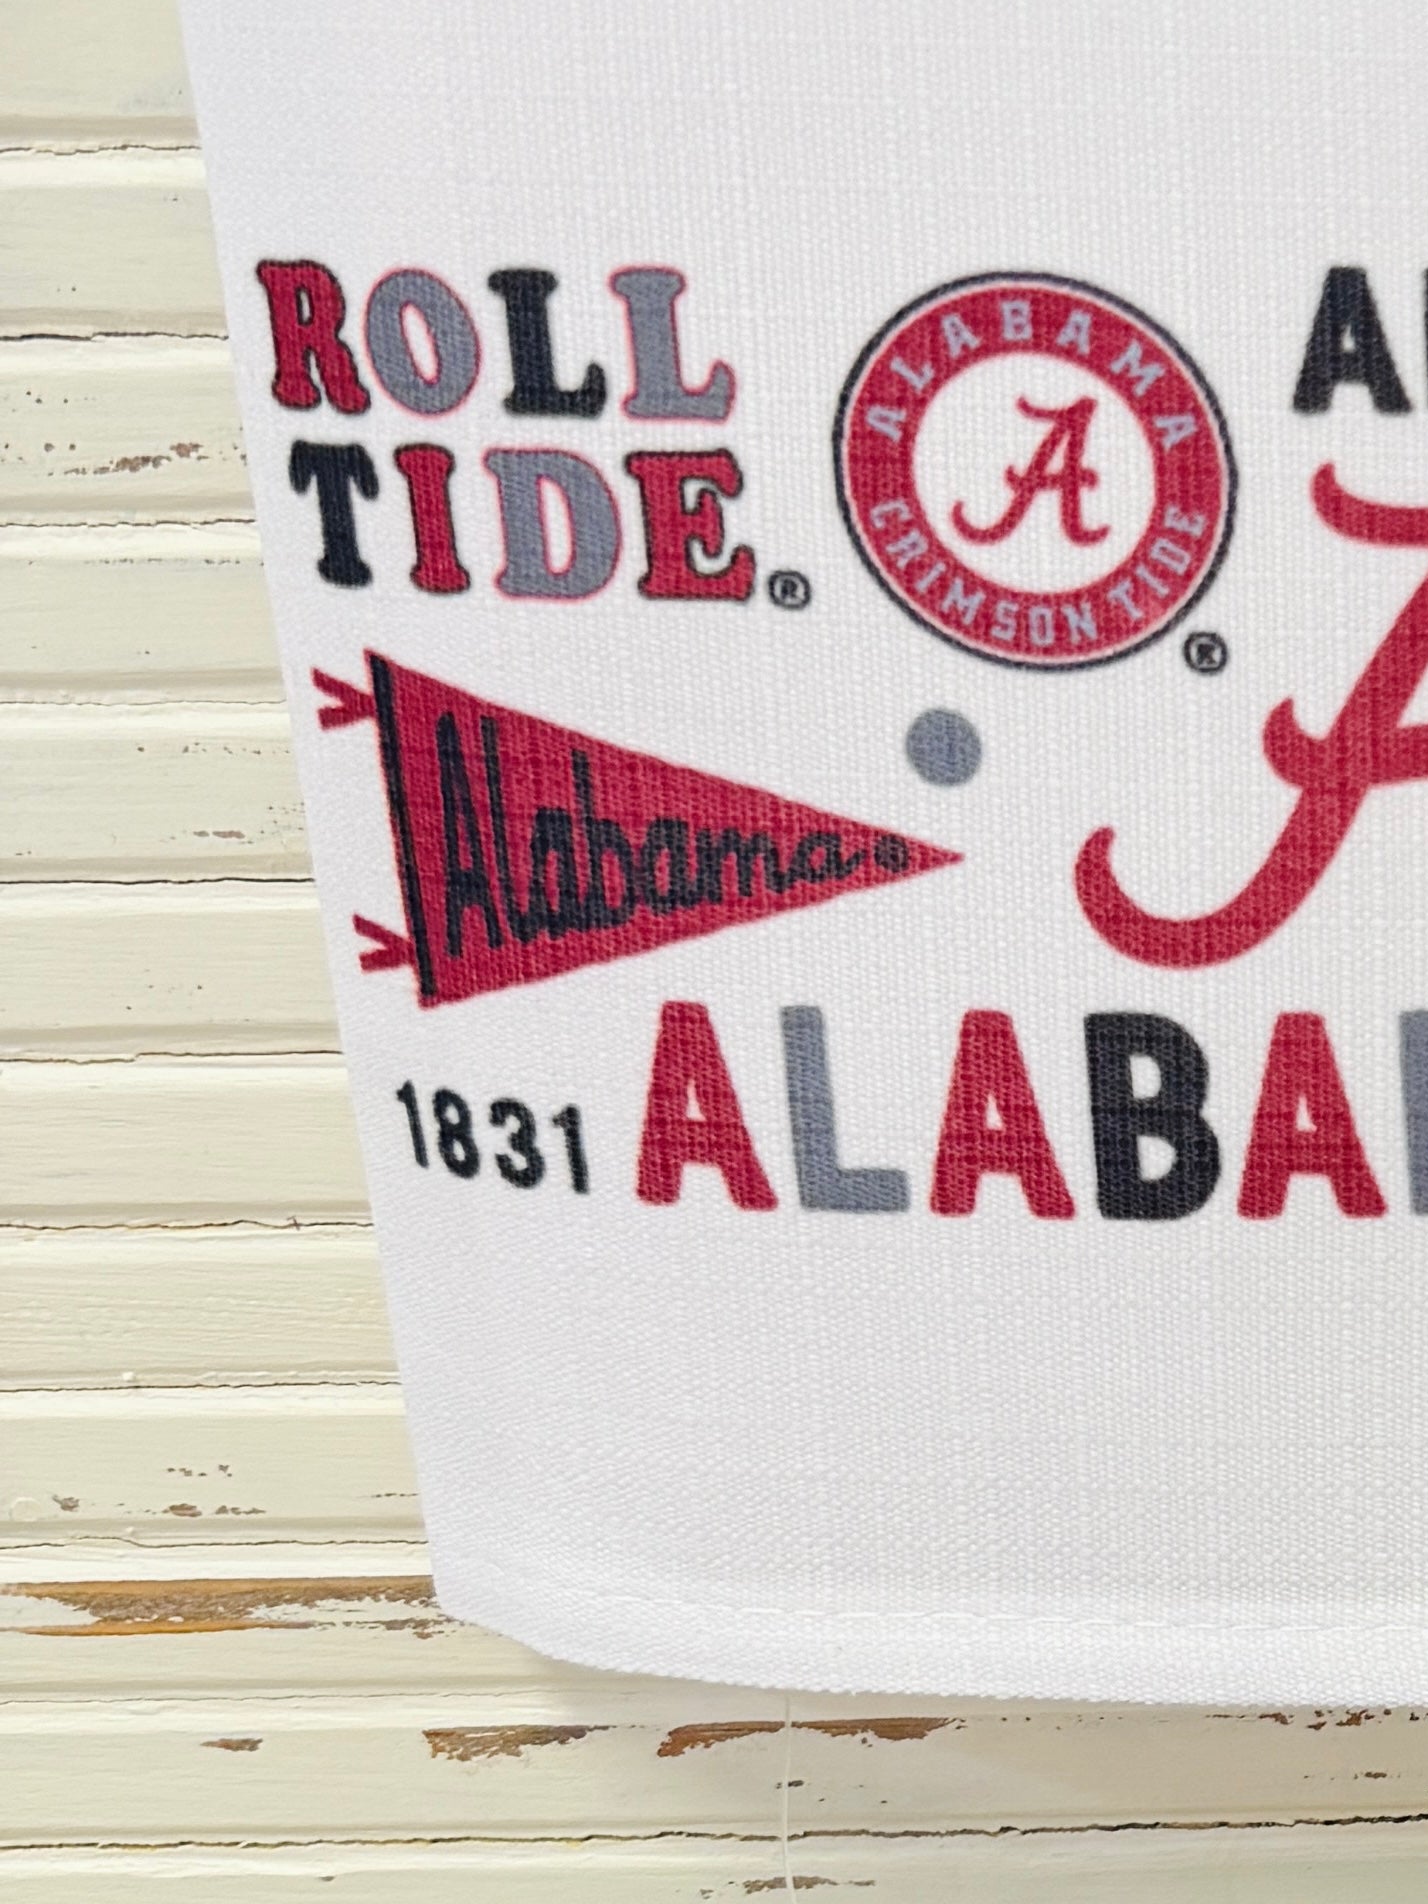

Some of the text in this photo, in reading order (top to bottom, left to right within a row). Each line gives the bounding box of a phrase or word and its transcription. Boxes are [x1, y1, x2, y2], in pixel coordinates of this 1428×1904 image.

[256, 258, 738, 424] ROLL
[866, 299, 1198, 450] ALABAMA
[289, 440, 756, 604] TIDE
[870, 499, 1207, 648] CRIMSON TIDE
[437, 710, 867, 958] Alabama
[396, 1081, 590, 1196] 1831
